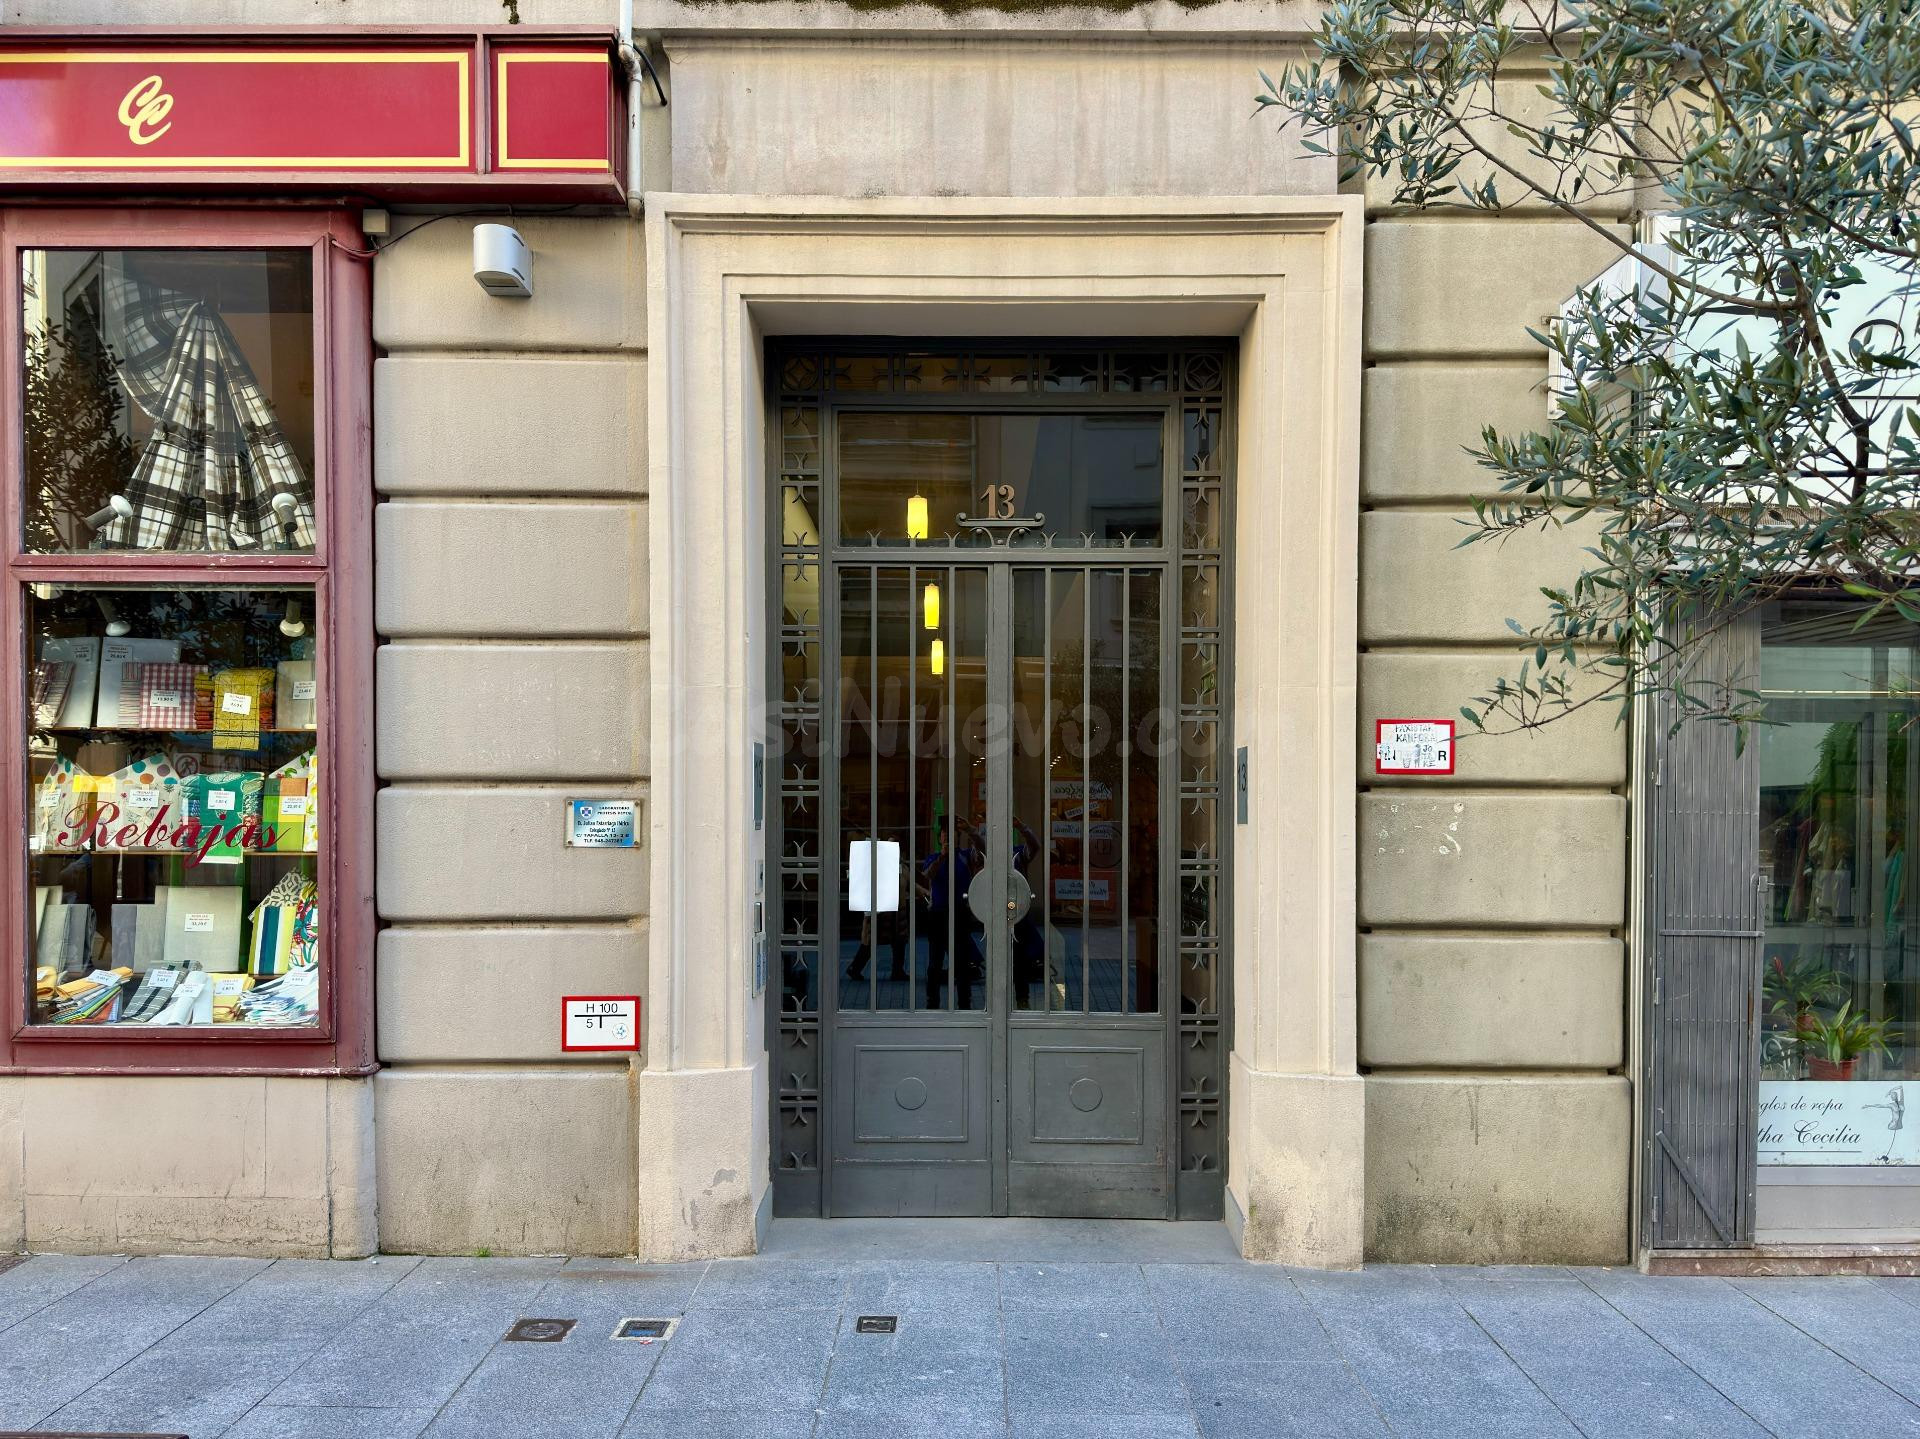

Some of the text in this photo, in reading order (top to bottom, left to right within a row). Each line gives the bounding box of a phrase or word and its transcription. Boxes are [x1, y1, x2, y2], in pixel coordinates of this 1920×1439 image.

[980, 484, 1015, 519] 13
[1238, 763, 1247, 792] 13
[57, 800, 292, 869] Rebajas
[586, 1002, 618, 1013] H 100
[586, 1018, 593, 1029] 5
[1758, 1095, 1844, 1117] glos de ropa
[1757, 1119, 1862, 1146] tha Cecilia
